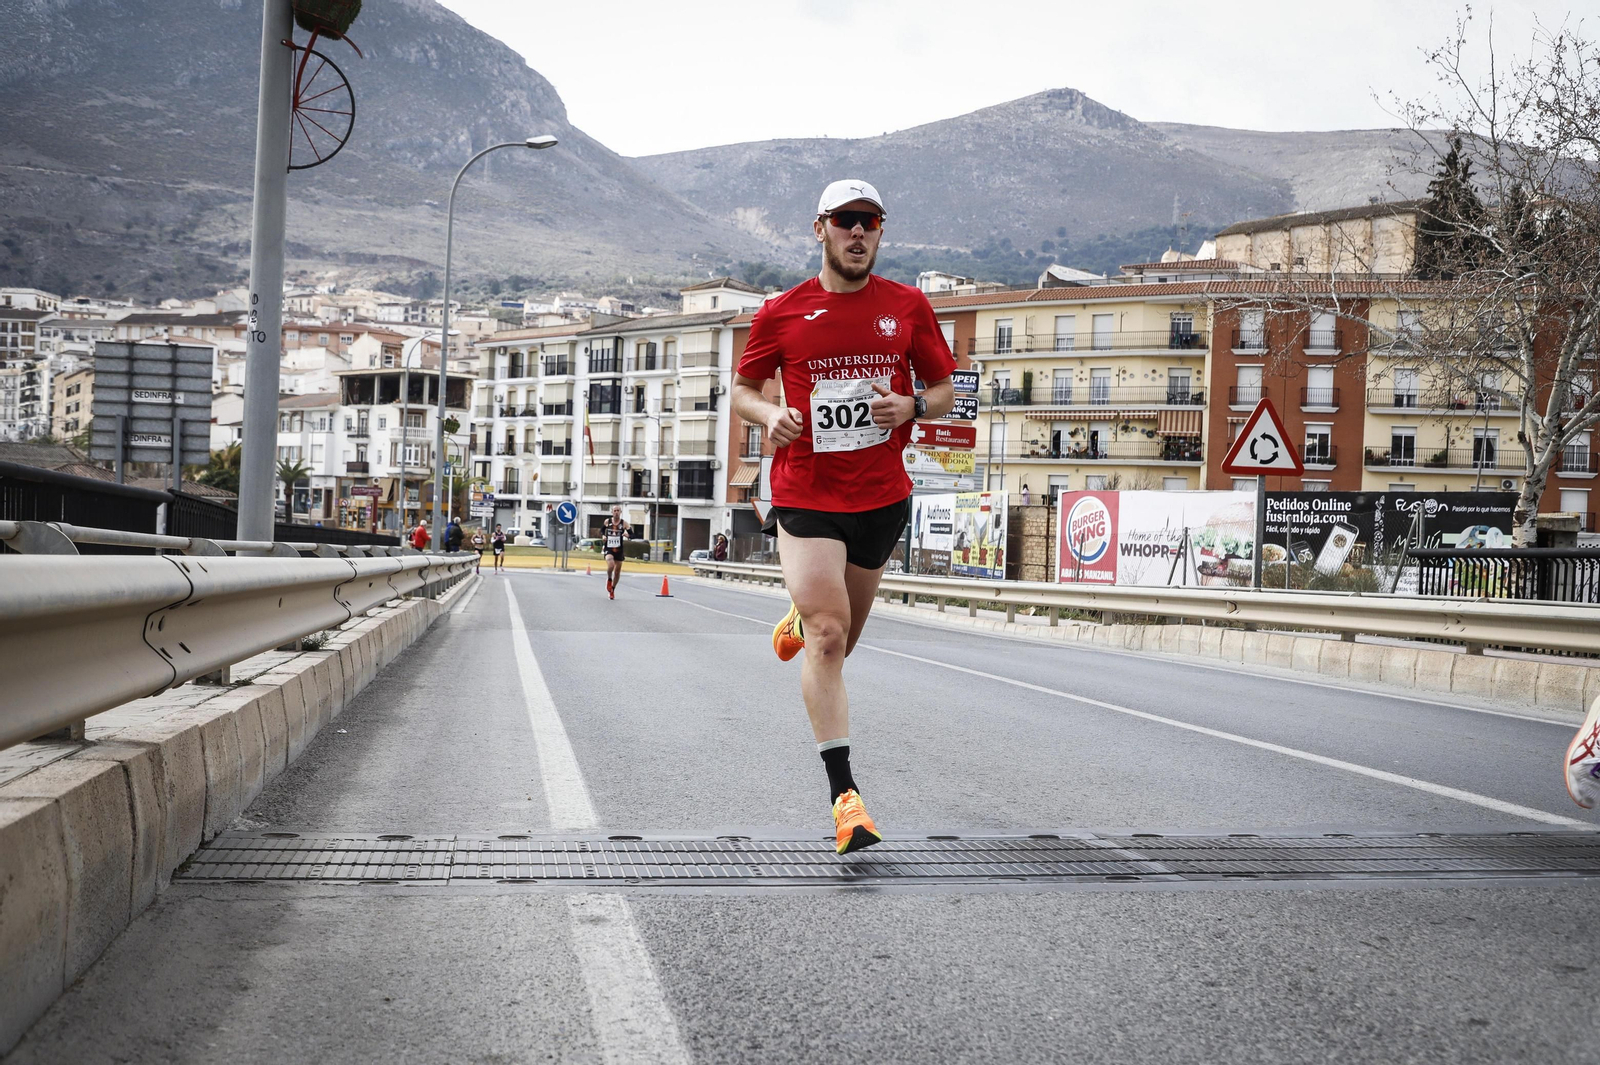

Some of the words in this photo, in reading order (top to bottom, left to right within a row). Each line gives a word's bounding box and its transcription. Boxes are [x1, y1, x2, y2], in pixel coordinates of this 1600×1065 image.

[807, 354, 900, 370] UNIVERSIDAD
[810, 373, 827, 383] DE
[829, 366, 896, 381] GRANADA
[951, 375, 977, 384] UPER
[134, 390, 172, 399] SEDINFRA
[817, 402, 878, 430] 302
[935, 435, 970, 445] Restaurante
[944, 451, 974, 460] SCHOOL
[1266, 498, 1309, 511] Pedidos
[1312, 498, 1351, 511] Online
[1452, 505, 1467, 513] Pasión
[1072, 510, 1104, 532] BURGER
[1265, 510, 1348, 526] fusionloja.com
[1072, 521, 1106, 548] KING
[1128, 529, 1152, 541] Home
[1153, 528, 1164, 543] of
[1165, 529, 1183, 542] the
[1304, 526, 1320, 535] rápido
